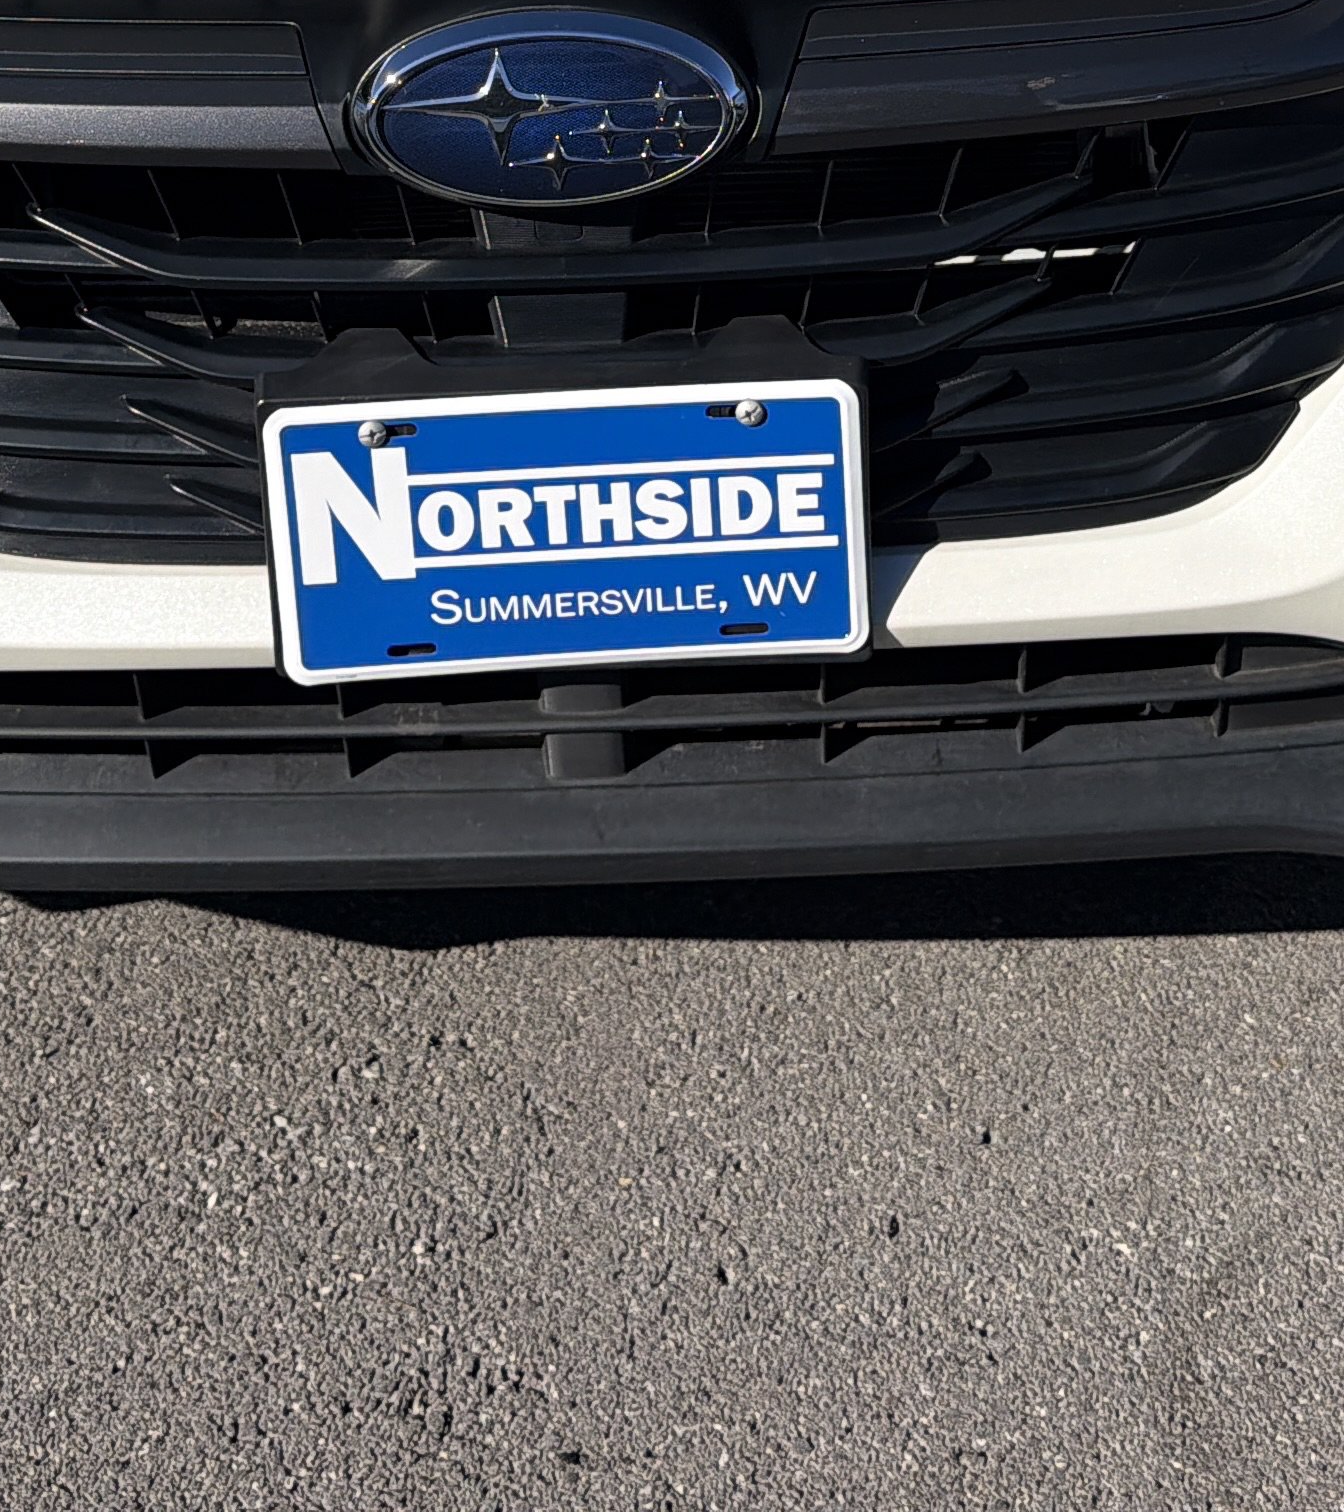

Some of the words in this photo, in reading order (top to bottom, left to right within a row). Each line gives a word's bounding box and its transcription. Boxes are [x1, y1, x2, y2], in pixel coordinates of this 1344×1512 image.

[290, 445, 825, 585] NORTHSIDE
[430, 583, 729, 625] SUMMERSVILLE,
[742, 571, 817, 607] WV
